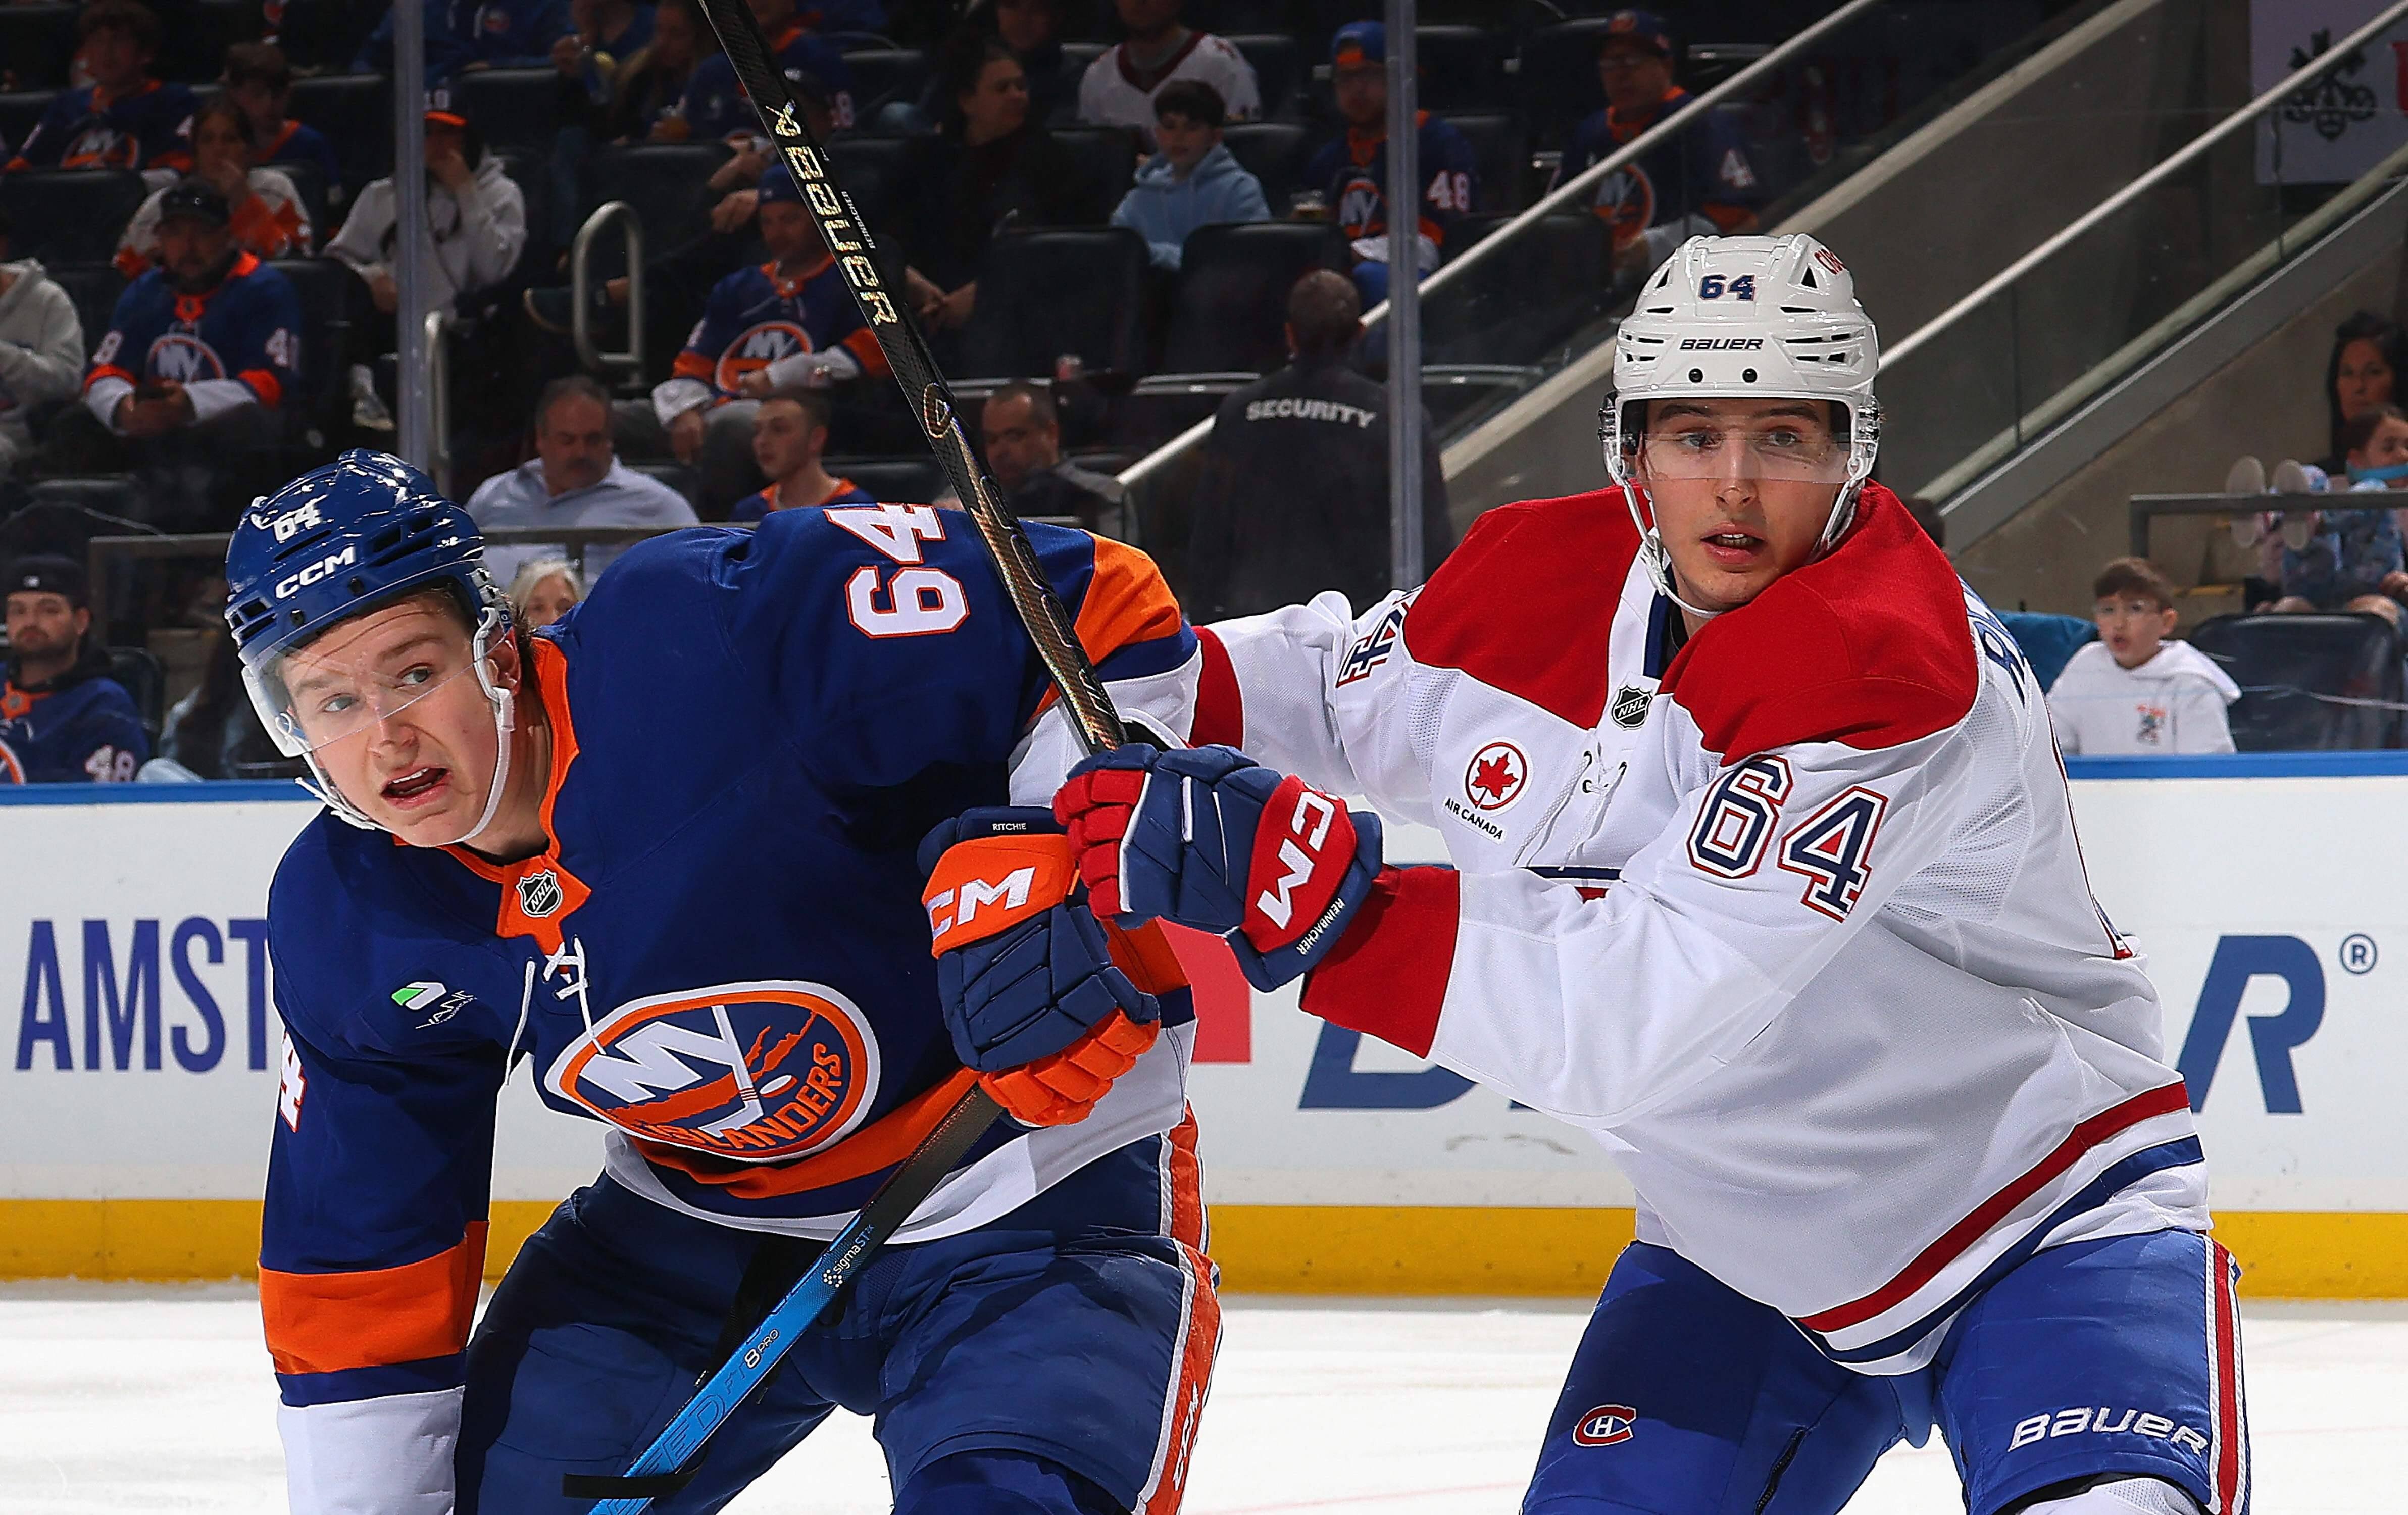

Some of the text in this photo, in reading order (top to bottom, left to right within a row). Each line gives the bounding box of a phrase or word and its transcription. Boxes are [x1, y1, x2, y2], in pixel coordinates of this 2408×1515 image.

[1426, 169, 1471, 211] 48
[785, 145, 899, 326] BAUER
[1697, 274, 1757, 302] 64
[1679, 338, 1764, 351] BAUER
[1245, 397, 1377, 429] SECURITY
[274, 503, 322, 542] 64
[275, 546, 356, 600] CCM
[823, 502, 970, 639] 64
[1618, 699, 1645, 718] NHL
[84, 744, 135, 782] 48
[992, 823, 1027, 831] RITCHIE
[1445, 798, 1503, 839] AIR CANADA
[1687, 754, 1888, 923] 64
[1256, 782, 1338, 930] CM
[530, 882, 551, 910] NHL
[1296, 897, 1346, 956] REINBACHER
[758, 1329, 778, 1353] PRO
[2008, 1406, 2208, 1456] BAUER
